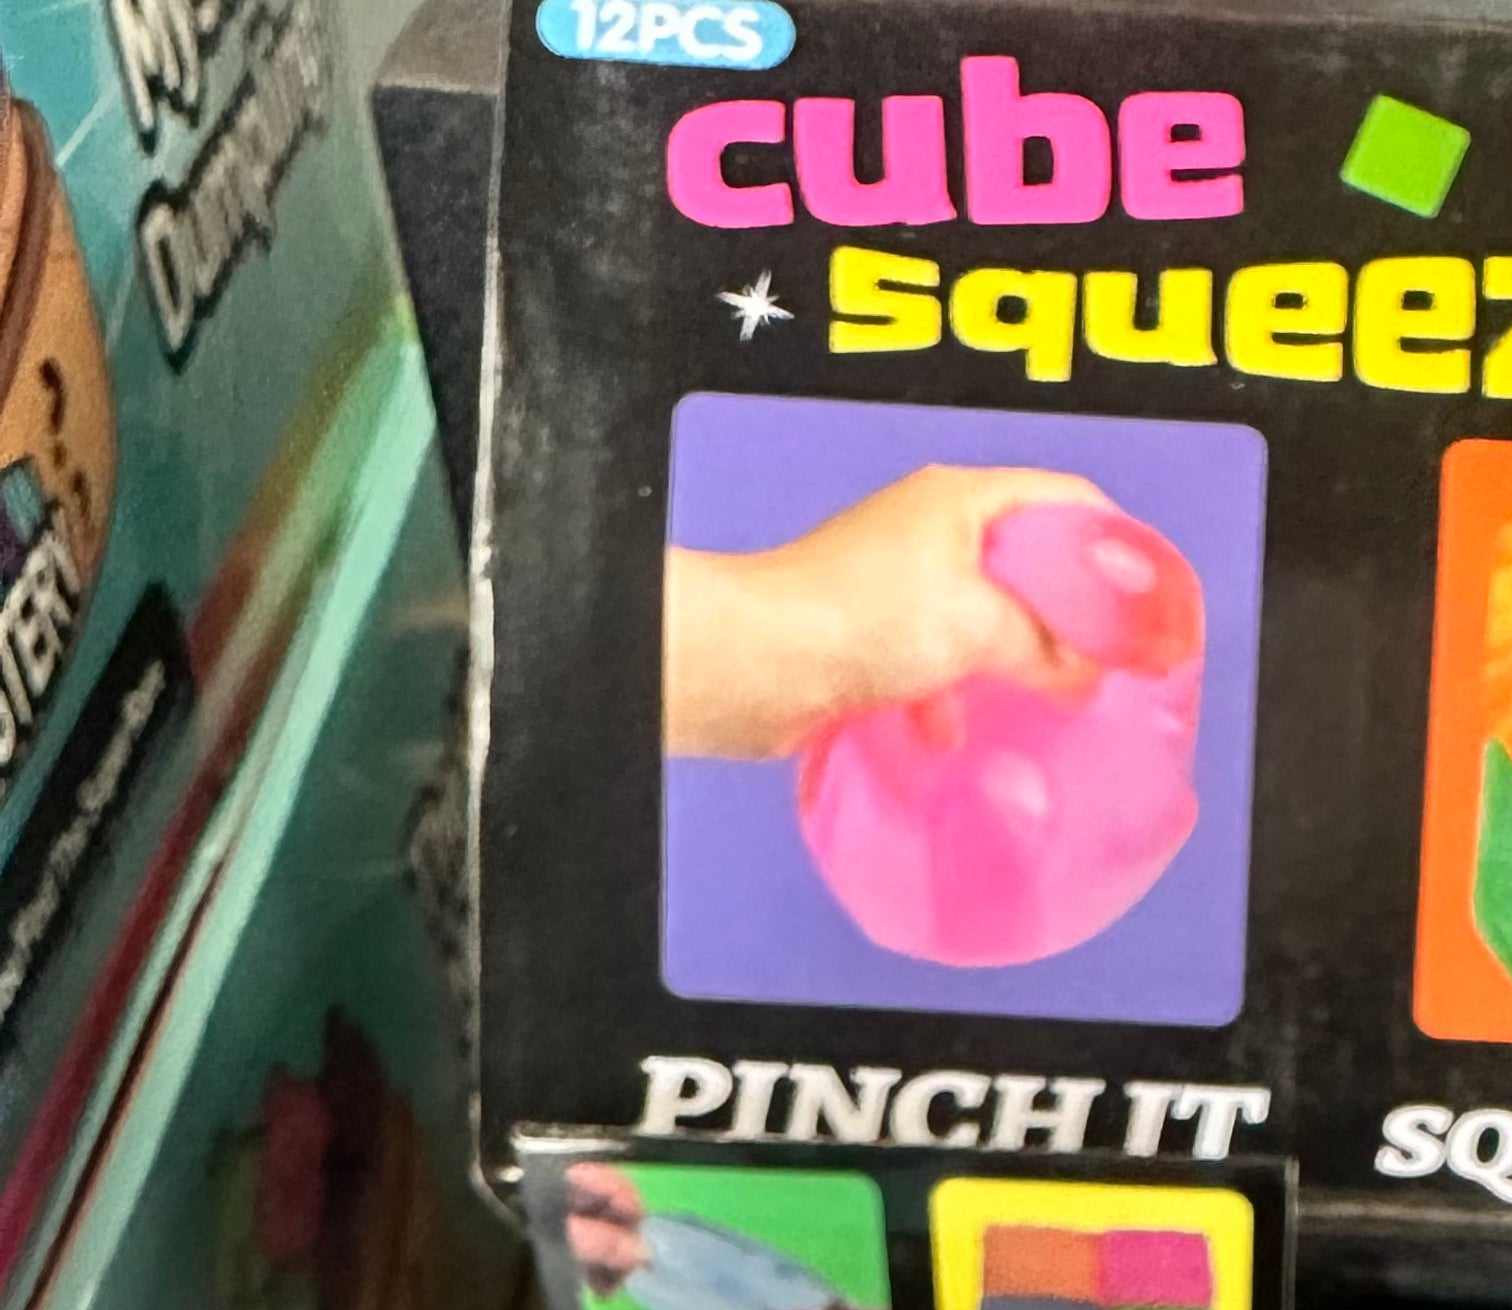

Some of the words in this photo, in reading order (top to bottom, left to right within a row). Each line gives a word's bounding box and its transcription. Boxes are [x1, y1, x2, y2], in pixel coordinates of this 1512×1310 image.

[570, 1, 764, 62] 12PCS
[665, 55, 1247, 229] cube
[632, 1055, 1106, 1152] PINCH
[1122, 1082, 1271, 1160] IT
